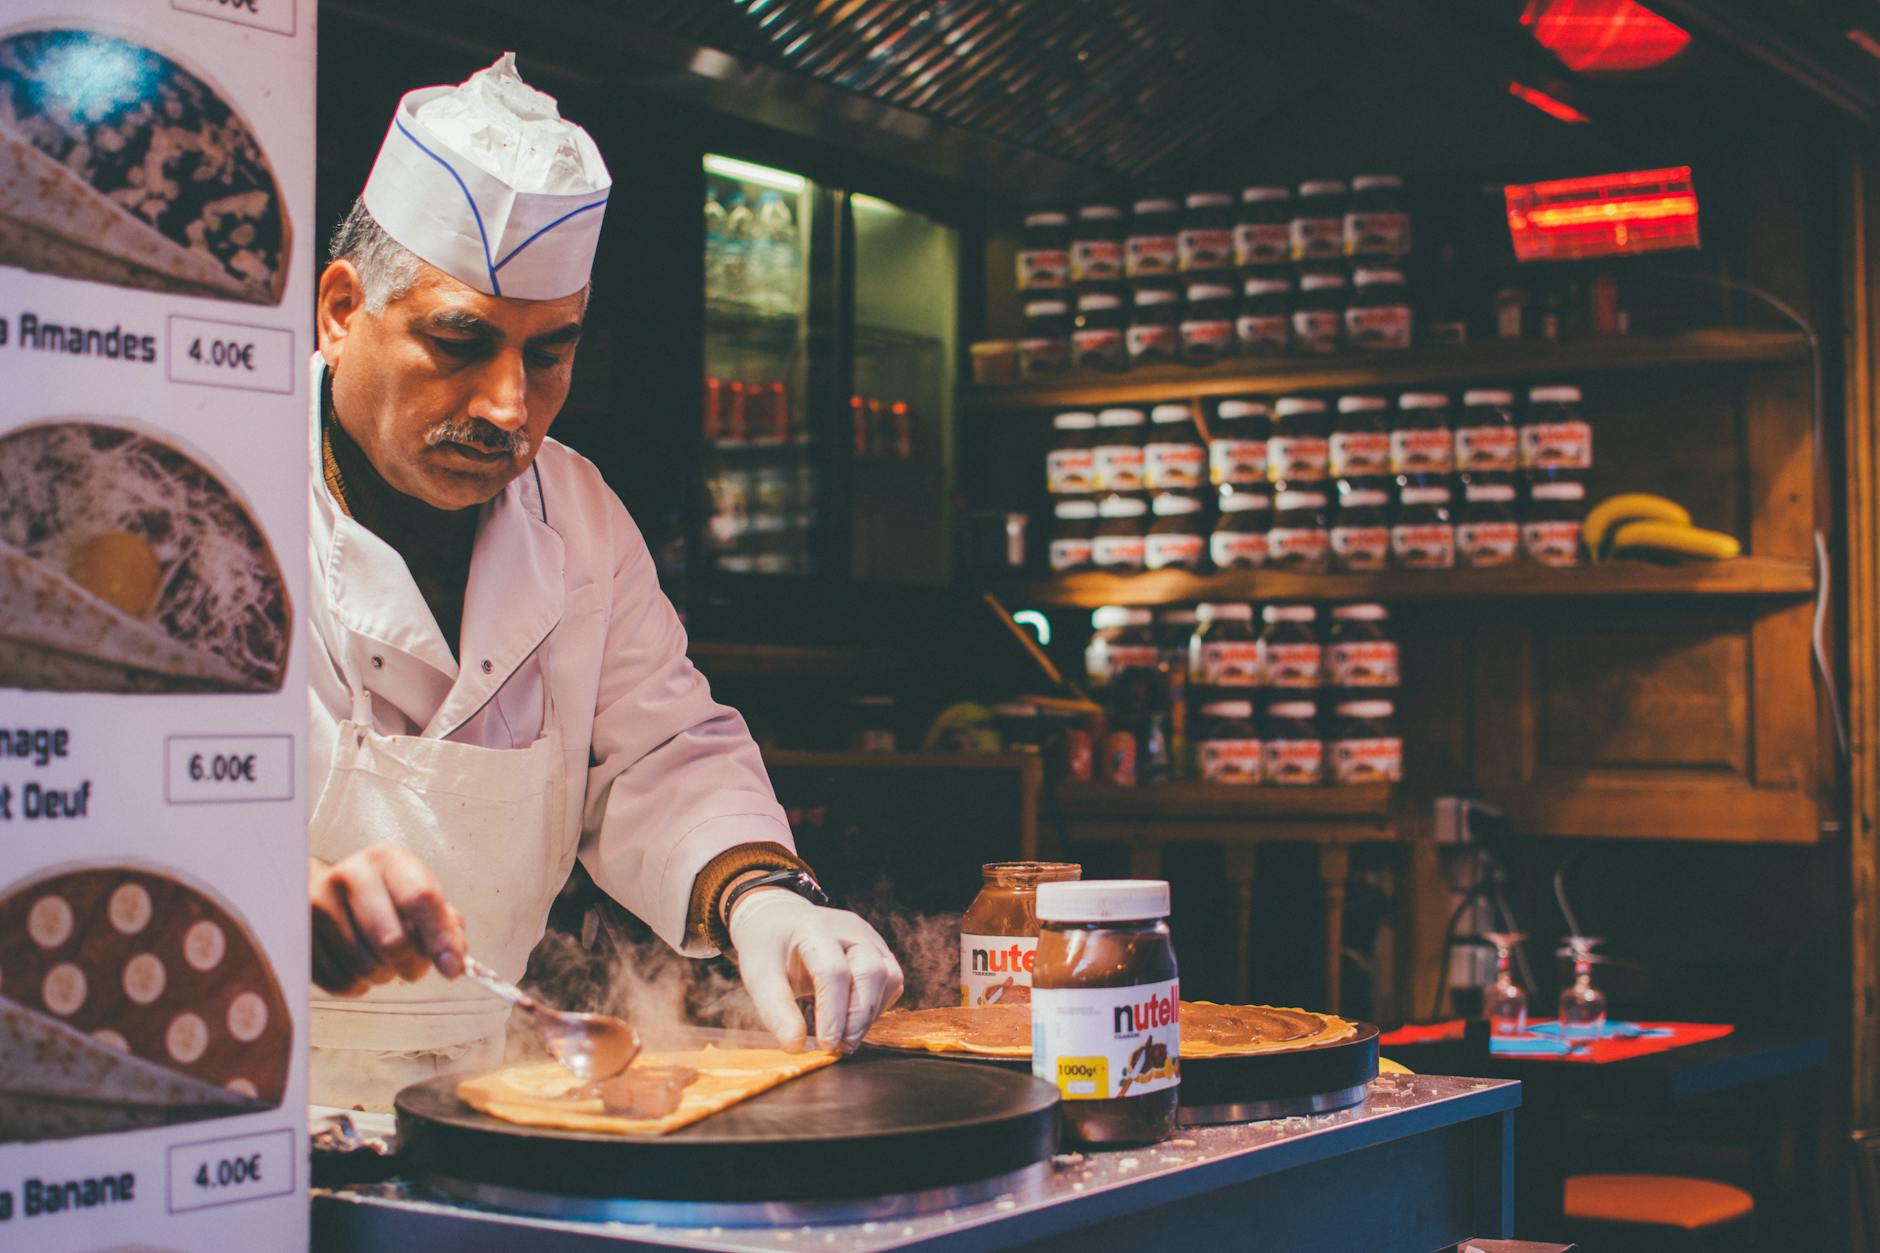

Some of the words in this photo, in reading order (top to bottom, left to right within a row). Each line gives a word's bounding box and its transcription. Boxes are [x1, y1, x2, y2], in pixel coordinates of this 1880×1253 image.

[19, 313, 156, 363] Amandes
[188, 338, 256, 371] 4.00€
[188, 754, 257, 782] 6.00€
[23, 781, 91, 820] Oeuf
[194, 1153, 263, 1188] 4.00€
[23, 1173, 135, 1218] Banane
